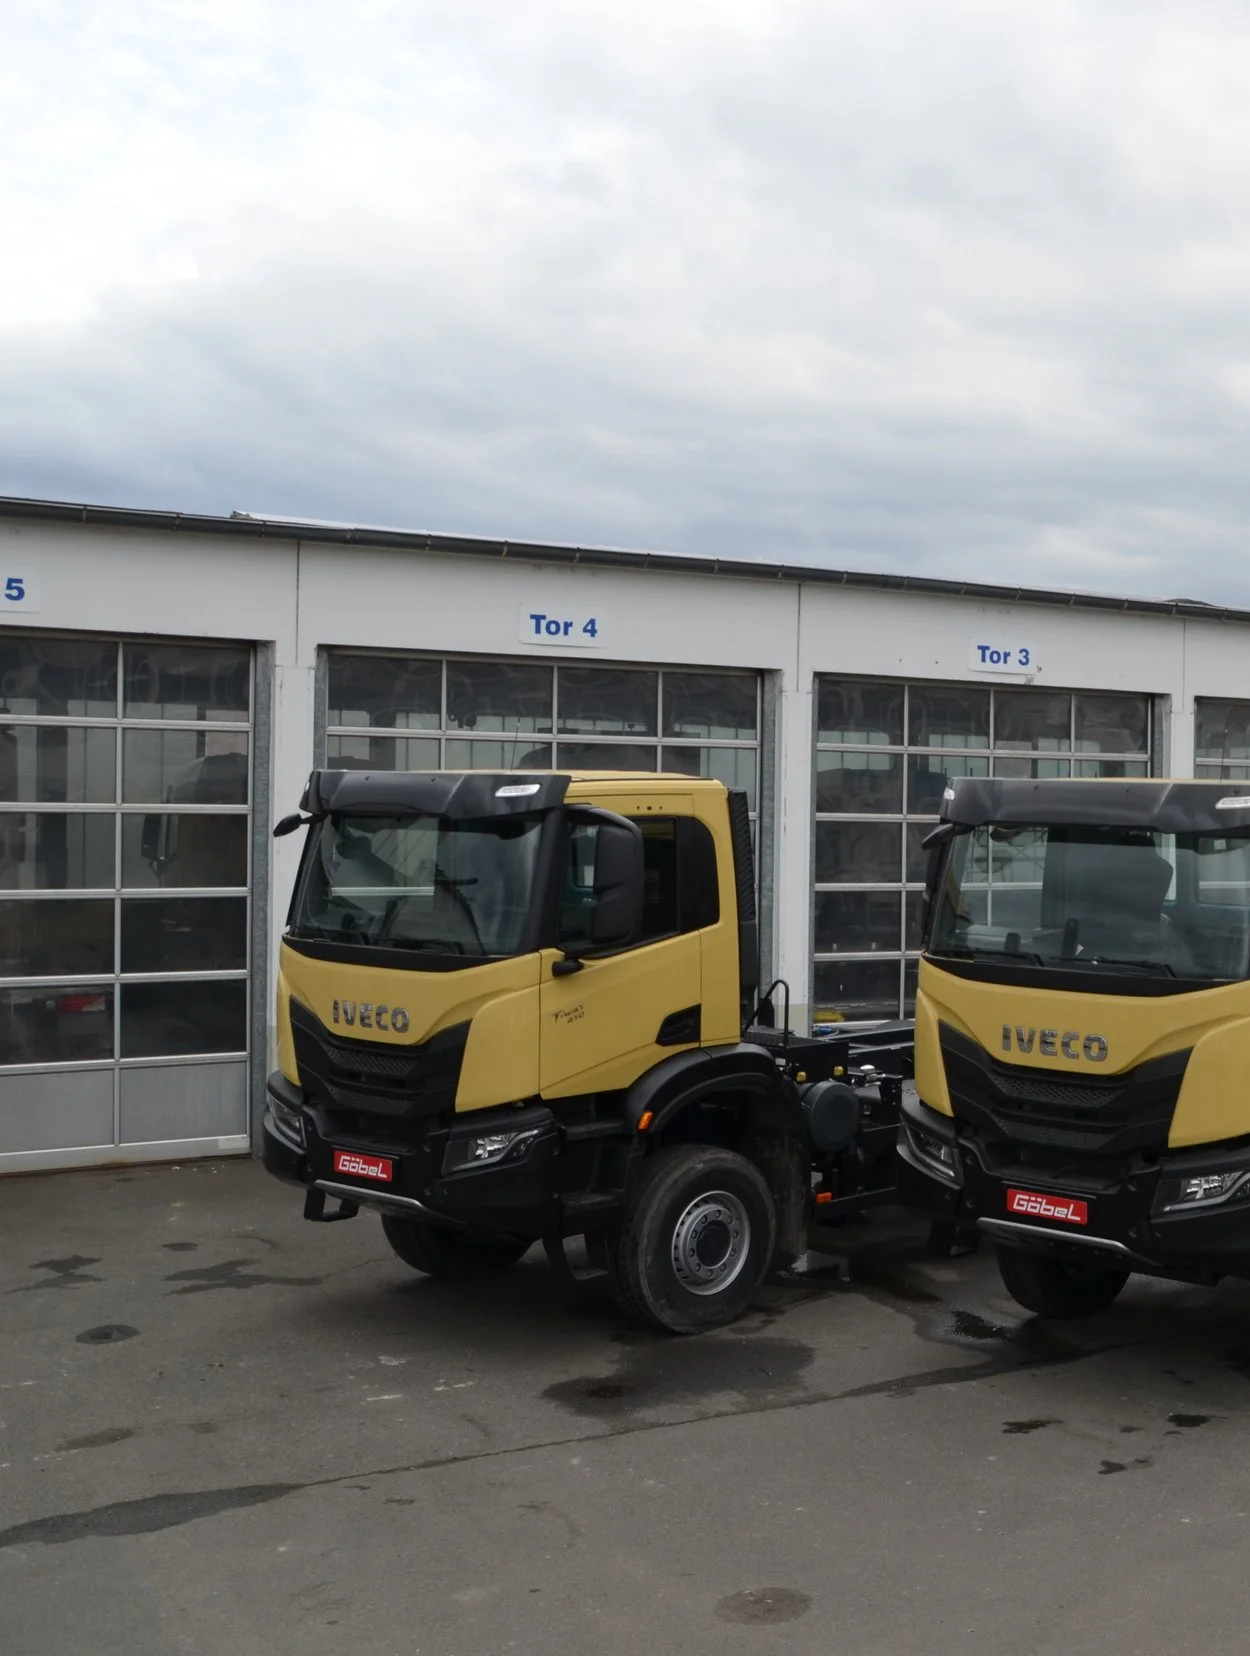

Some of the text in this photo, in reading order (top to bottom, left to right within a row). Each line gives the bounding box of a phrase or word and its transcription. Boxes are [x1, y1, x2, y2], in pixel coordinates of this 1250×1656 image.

[4, 577, 25, 601] 5
[529, 613, 598, 638] Tor 4
[976, 644, 1030, 666] Tor 3
[332, 999, 409, 1034] IVECO
[1002, 1023, 1109, 1062] IVECO
